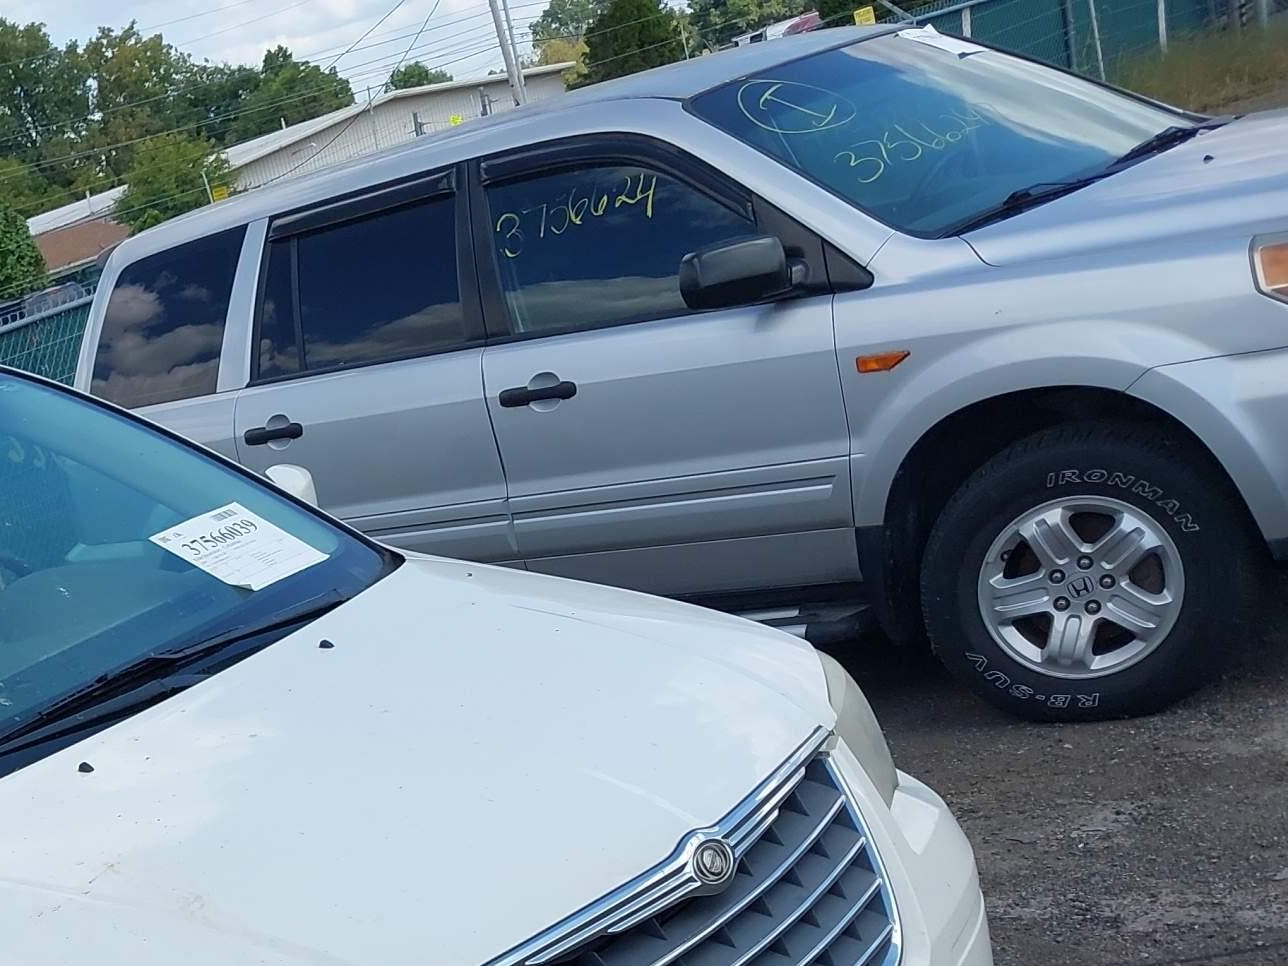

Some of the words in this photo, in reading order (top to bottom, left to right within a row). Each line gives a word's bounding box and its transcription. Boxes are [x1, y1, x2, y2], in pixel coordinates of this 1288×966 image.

[1046, 469, 1200, 533] IRONMAN
[181, 518, 258, 556] 37566039
[965, 651, 1100, 709] RB-SUV
